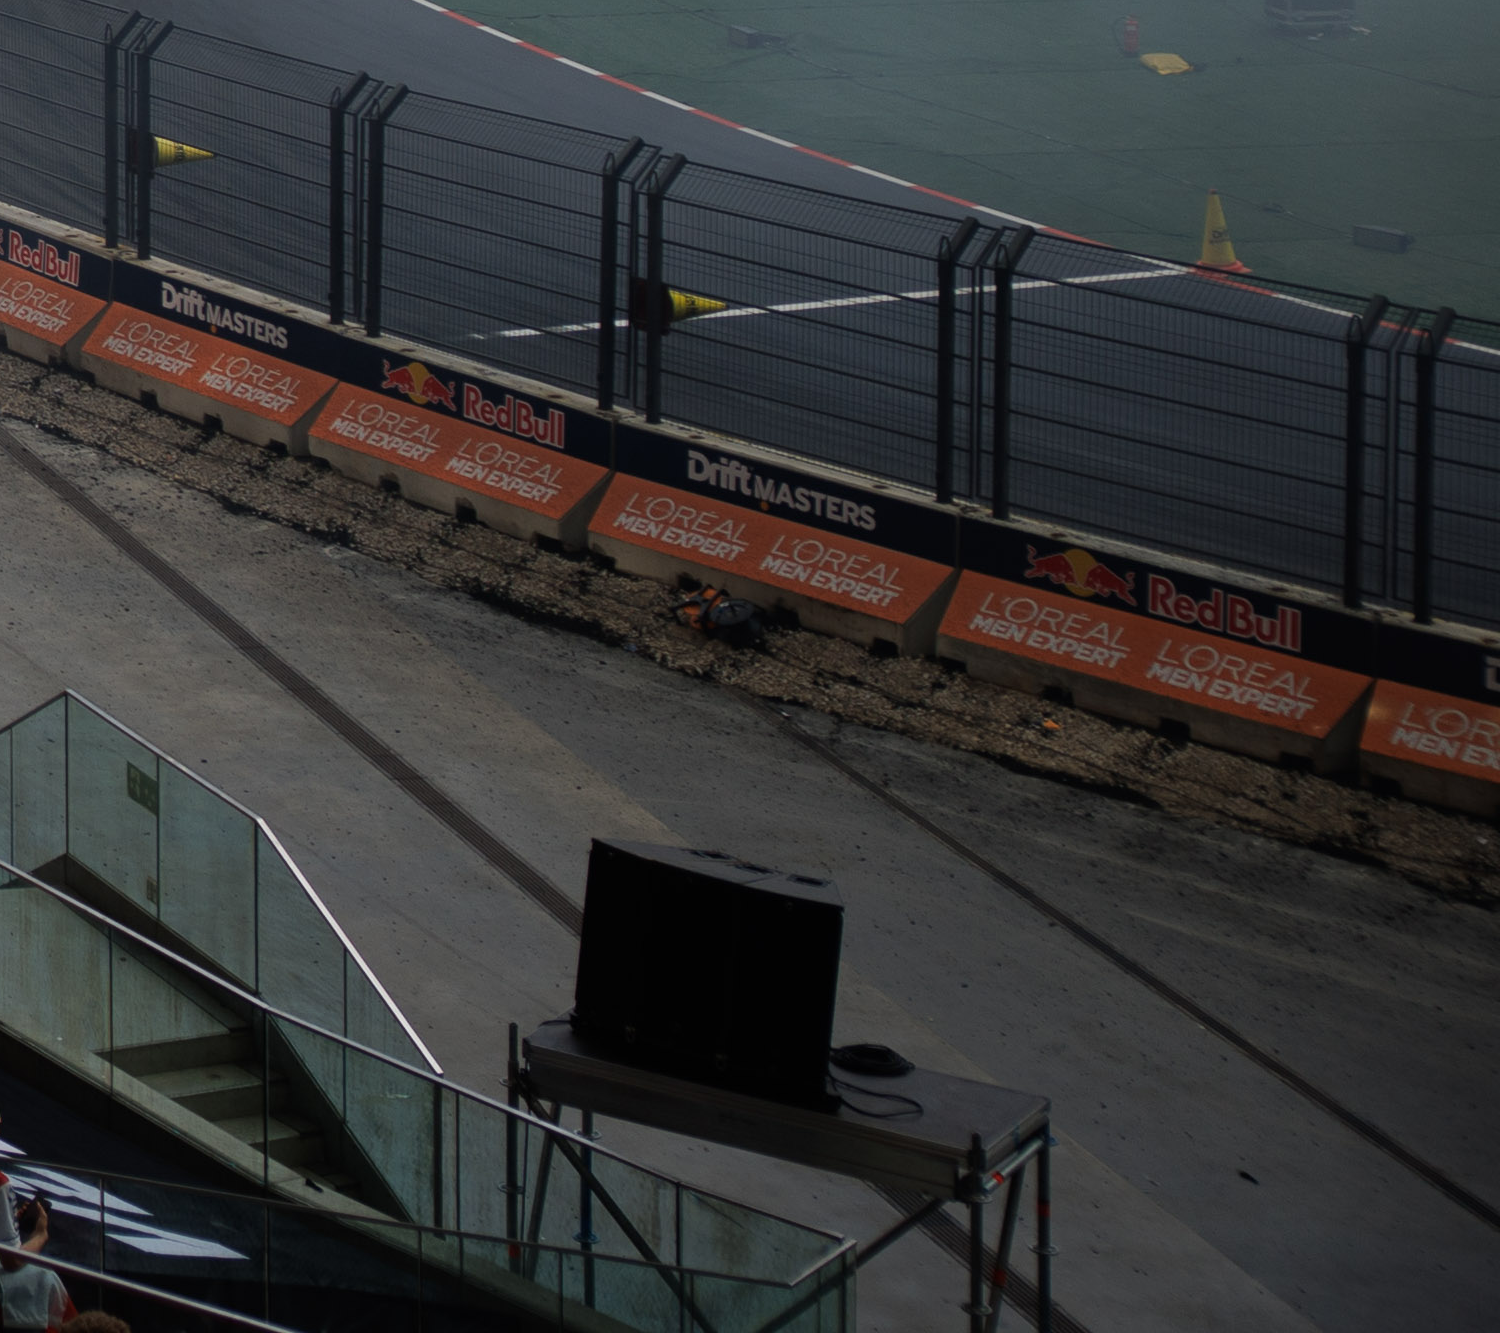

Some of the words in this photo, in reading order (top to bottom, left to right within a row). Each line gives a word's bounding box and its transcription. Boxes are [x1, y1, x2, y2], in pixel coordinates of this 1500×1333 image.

[113, 318, 199, 359] L'ORÉAL
[207, 302, 288, 348] MASTERS
[103, 337, 138, 360] MEN
[135, 347, 193, 376] EXPERT
[329, 418, 369, 443] MEN
[367, 429, 435, 462] EXPERT
[341, 399, 441, 447] L'ORÉAL
[446, 458, 489, 485] MEN
[487, 469, 558, 504] EXPERT
[457, 437, 562, 489] L'ORÉAL
[752, 475, 876, 531] MASTERS
[761, 555, 812, 583] MEN
[813, 570, 899, 607] EXPERT
[771, 535, 903, 591] L'ORÉAL
[970, 614, 1028, 645] MEN
[1028, 630, 1126, 668] EXPERT
[980, 591, 1130, 652] L'ORÉAL
[1146, 662, 1208, 693] MEN
[1210, 679, 1314, 719] EXPERT
[1157, 638, 1317, 702] L'ORÉAL
